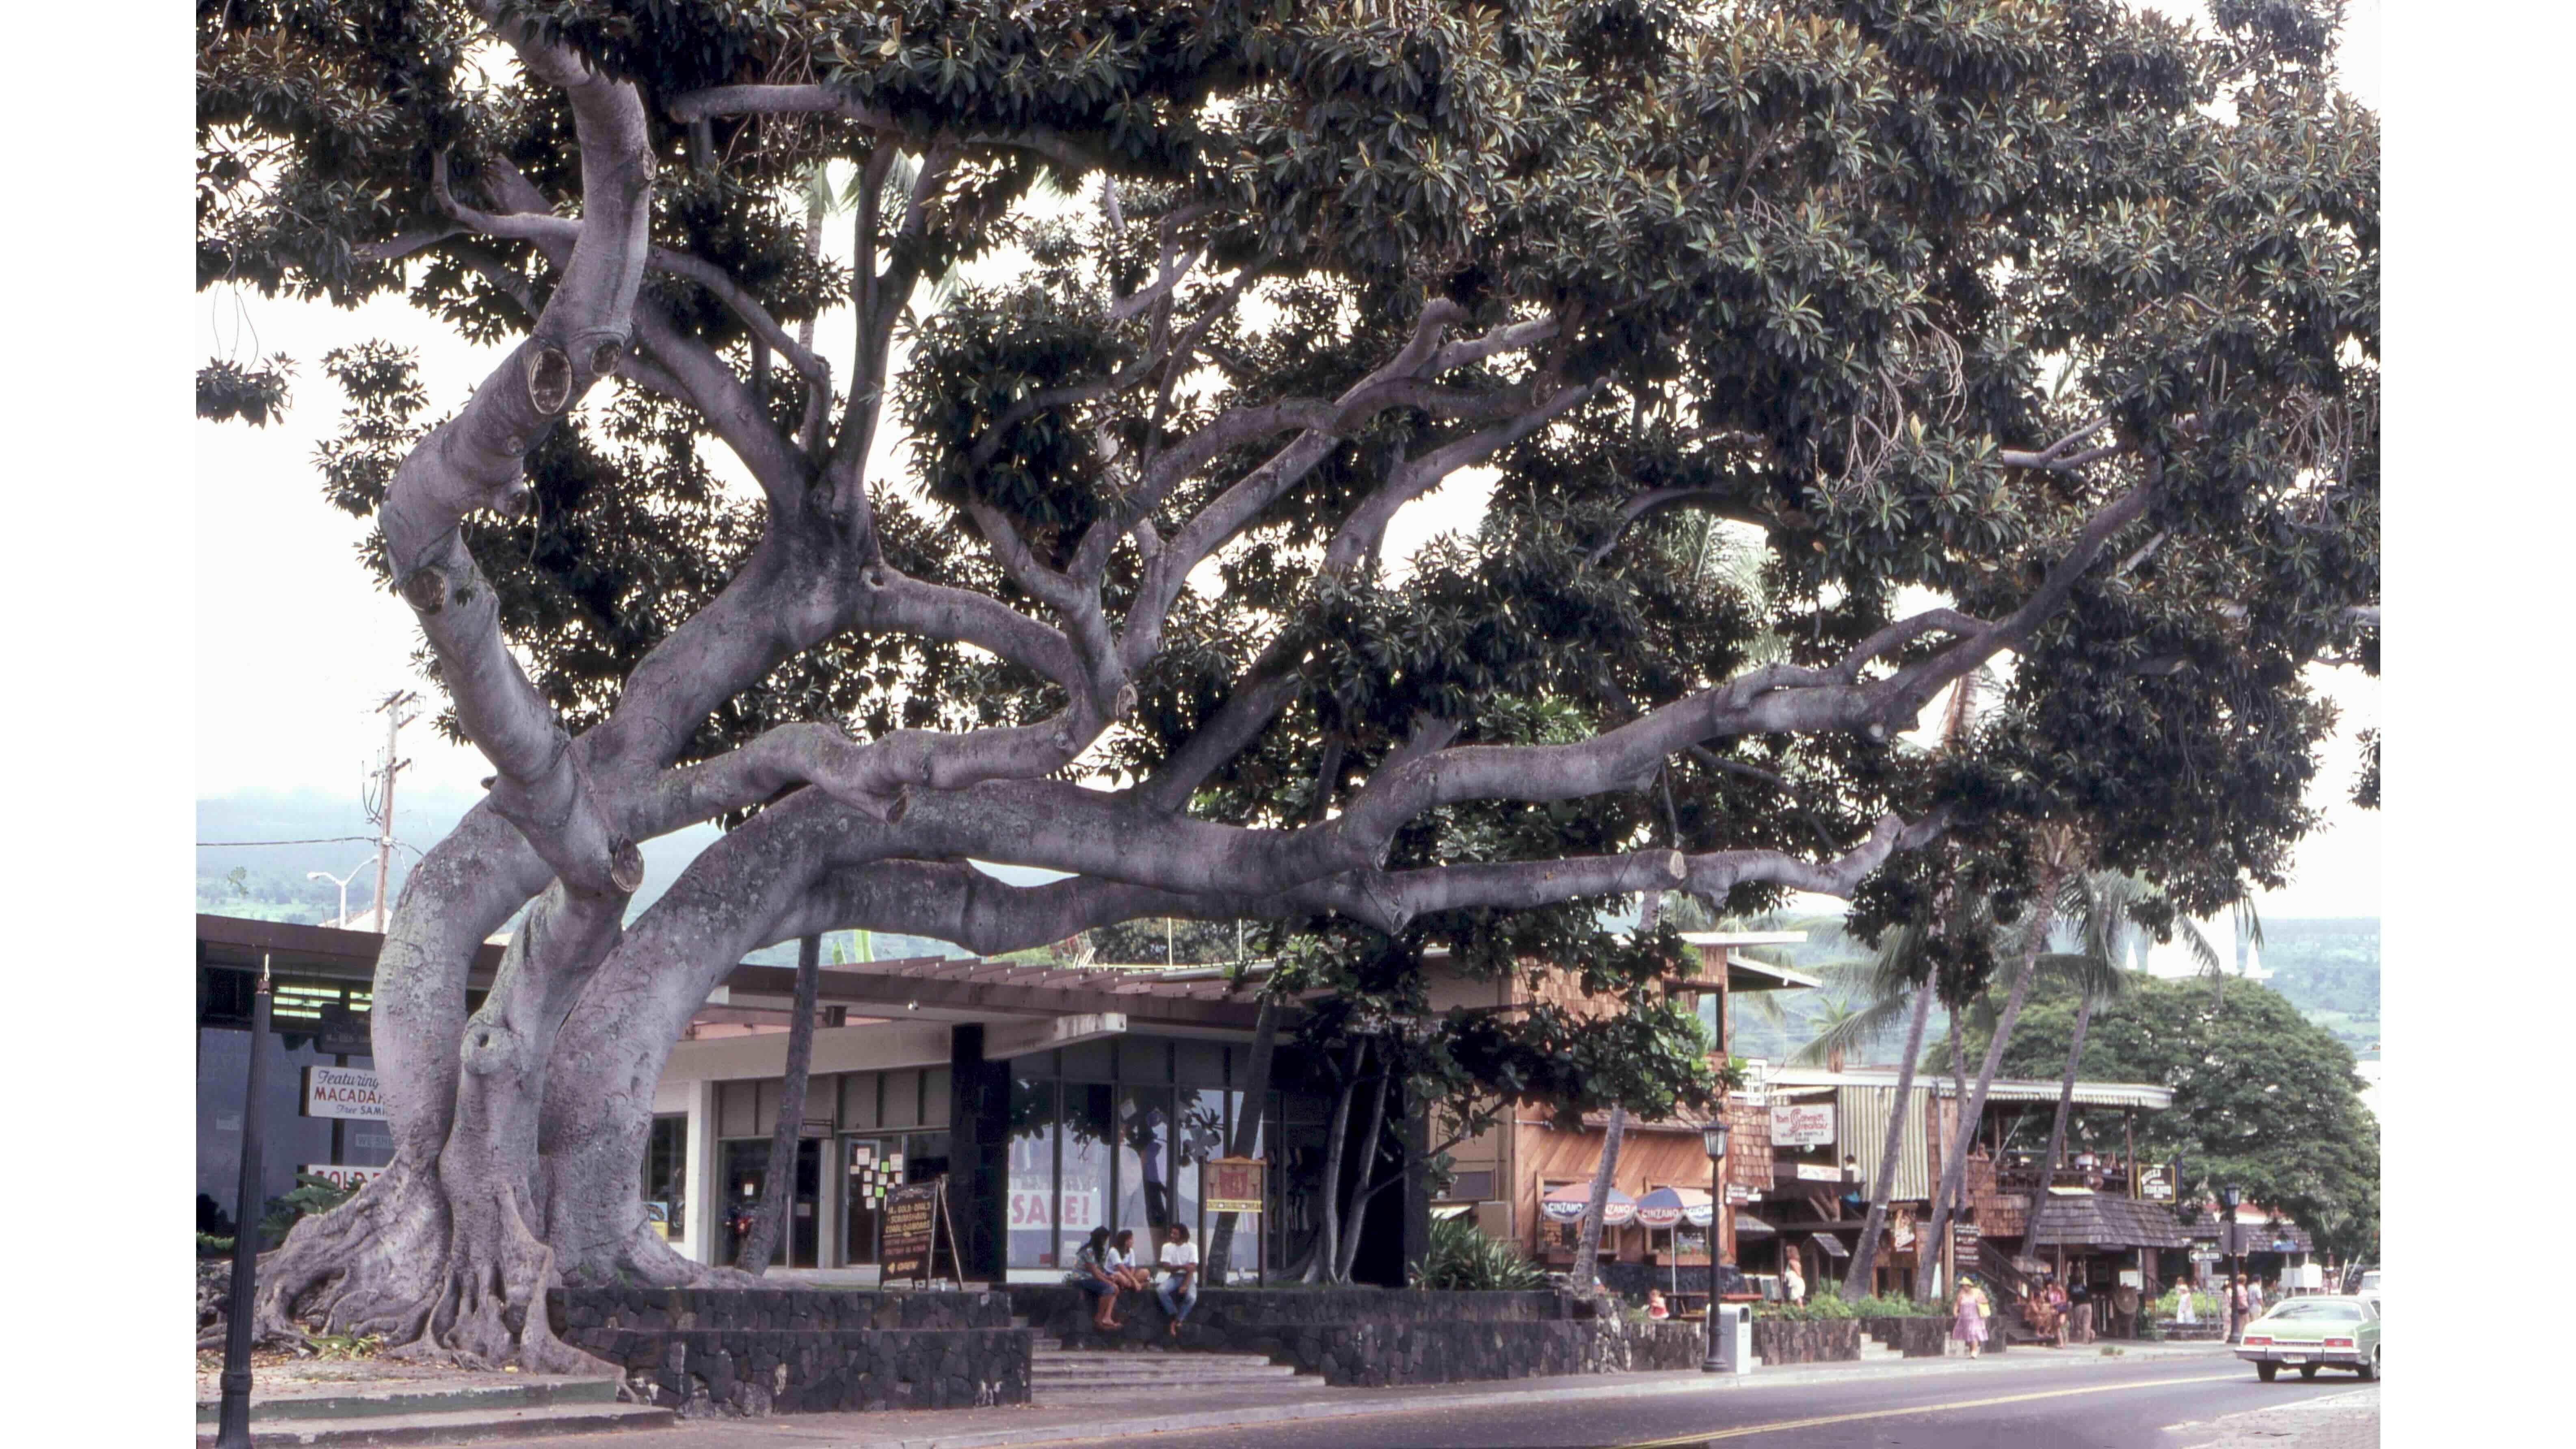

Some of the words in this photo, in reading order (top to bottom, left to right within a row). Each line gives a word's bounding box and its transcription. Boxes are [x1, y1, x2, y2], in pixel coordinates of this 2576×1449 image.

[317, 1070, 379, 1089] Featuring
[360, 1105, 385, 1115] SAM
[1012, 1194, 1090, 1226] SAE!
[1548, 1202, 1583, 1213] CINZANO
[1642, 1208, 1678, 1220] CINZANO
